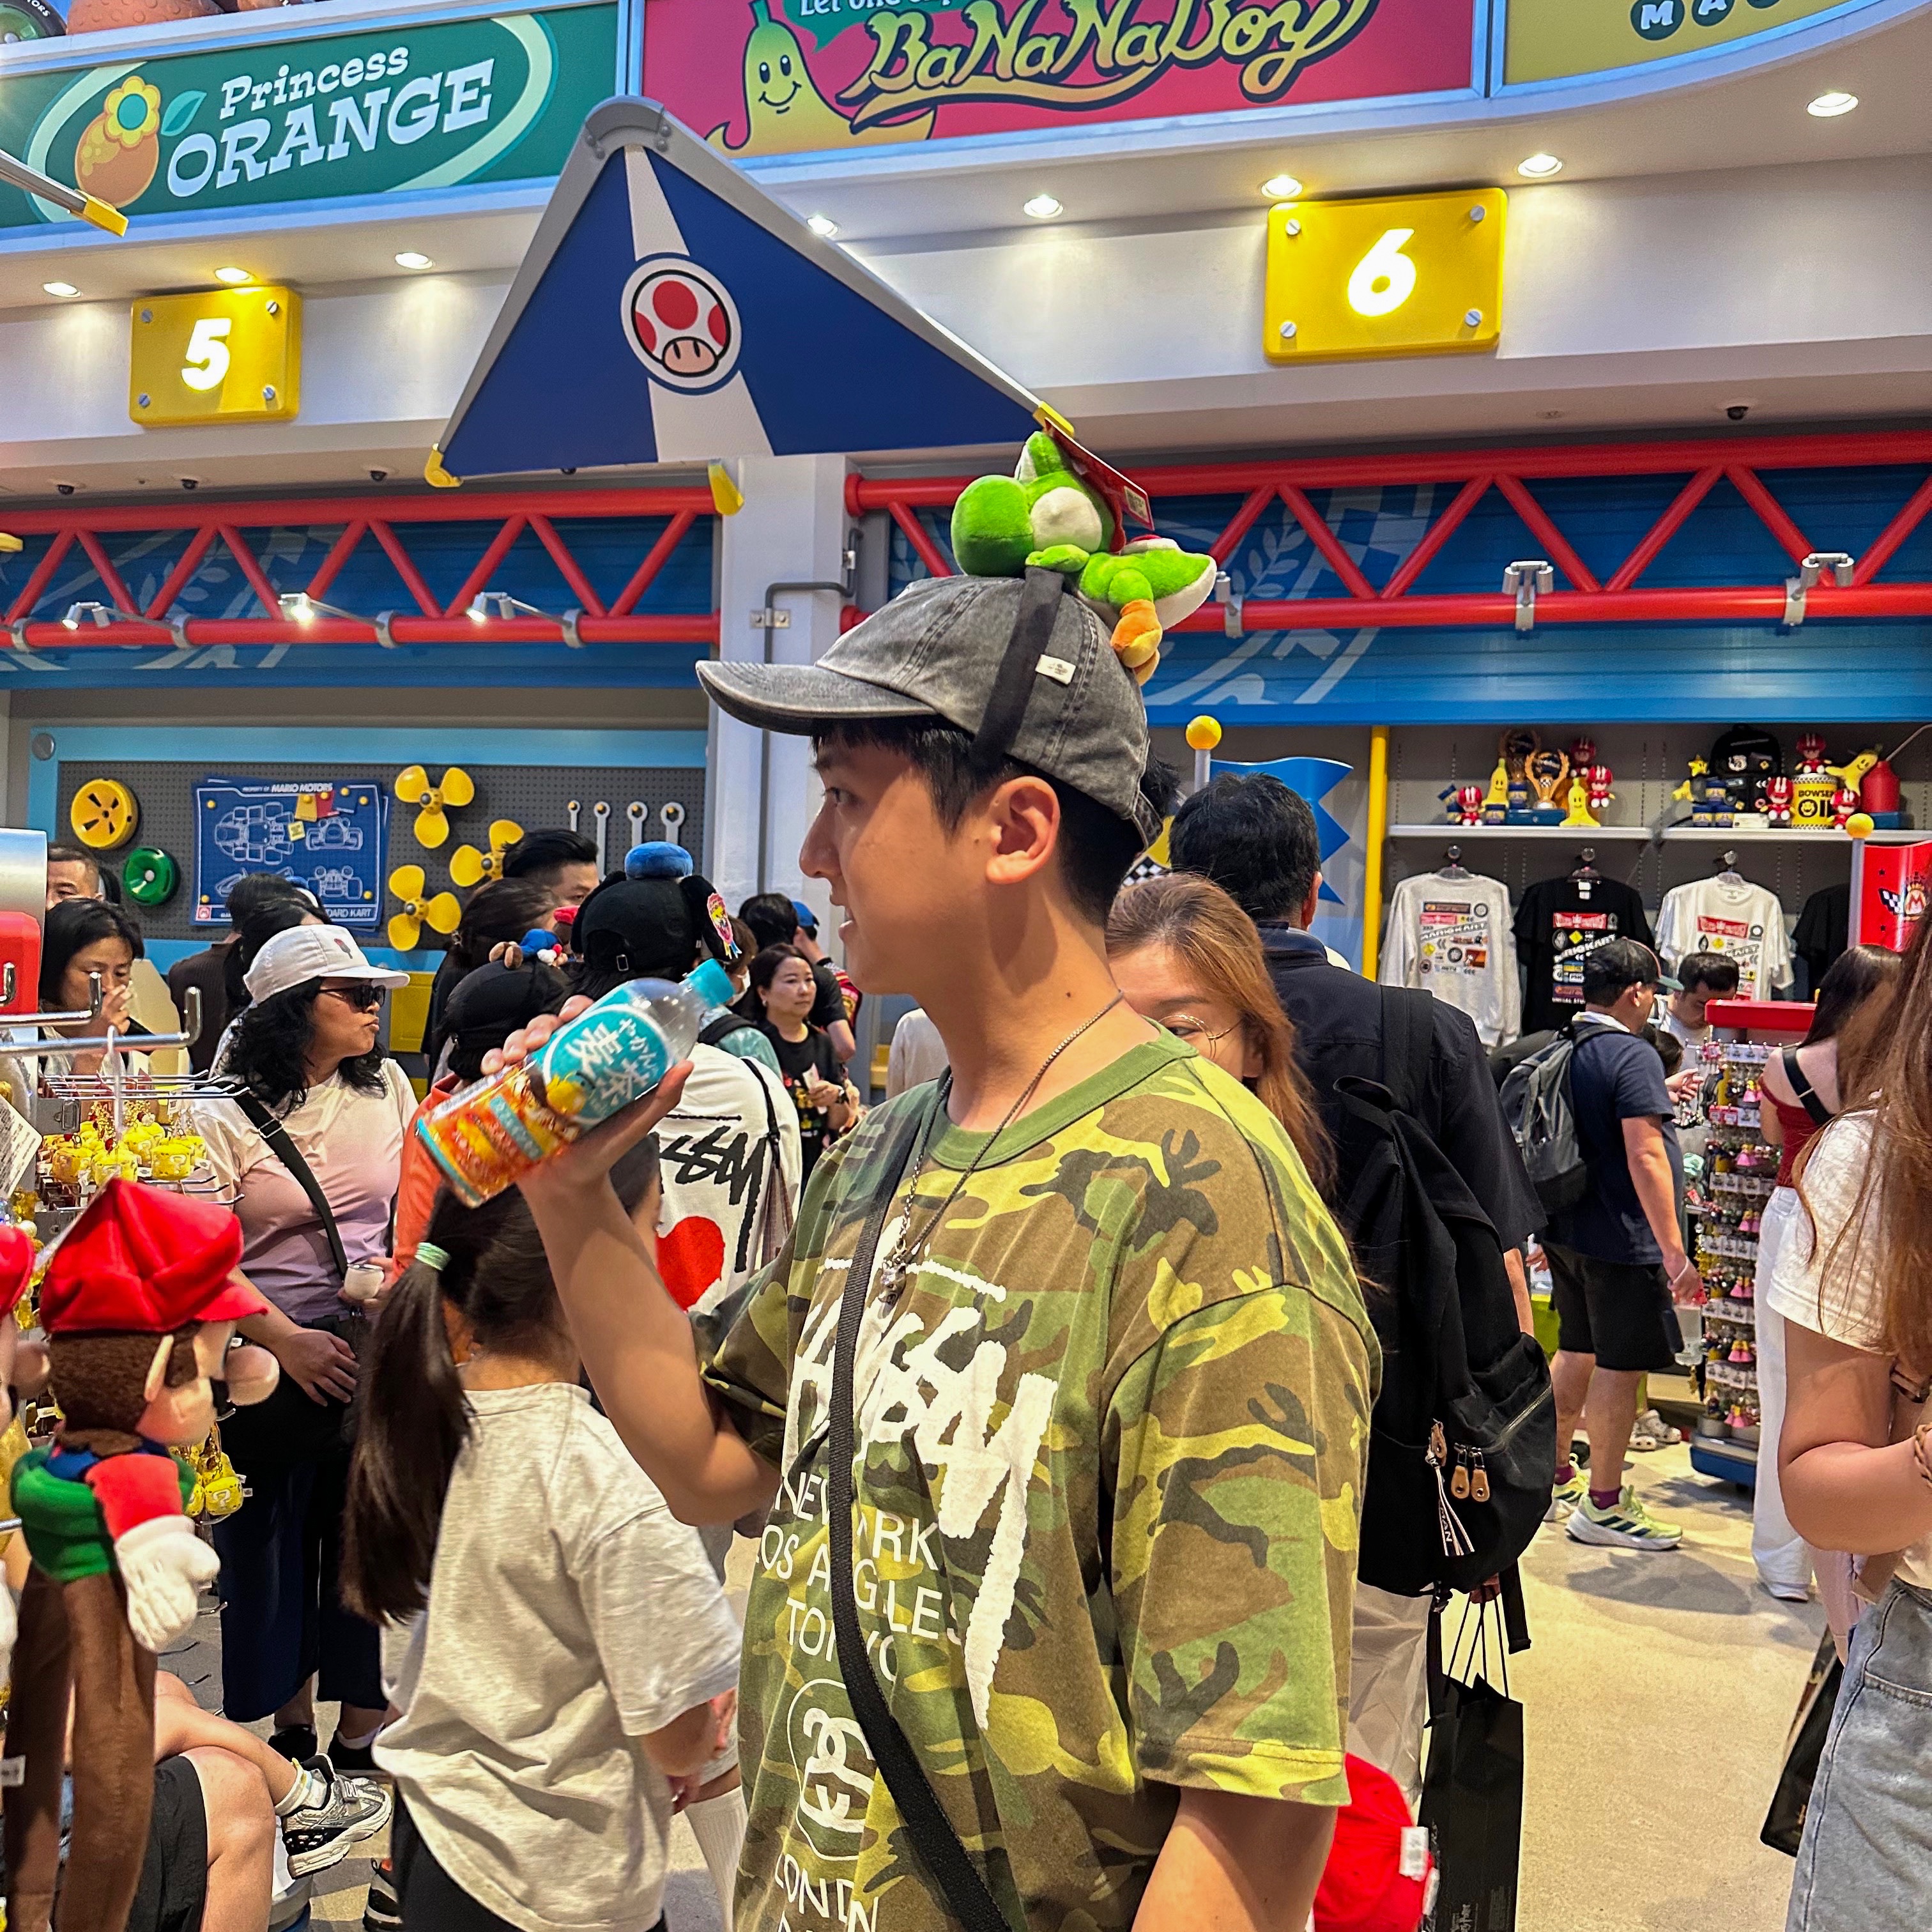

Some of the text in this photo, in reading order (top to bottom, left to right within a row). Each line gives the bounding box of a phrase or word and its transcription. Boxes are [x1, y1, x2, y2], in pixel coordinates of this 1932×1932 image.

[220, 47, 410, 120] Princess
[167, 57, 495, 197] ORANGE
[1347, 227, 1417, 318] 6
[180, 318, 232, 392] 5
[272, 783, 299, 793] MARIO
[300, 783, 333, 792] MOTORS
[564, 1021, 650, 1106] 麦茶
